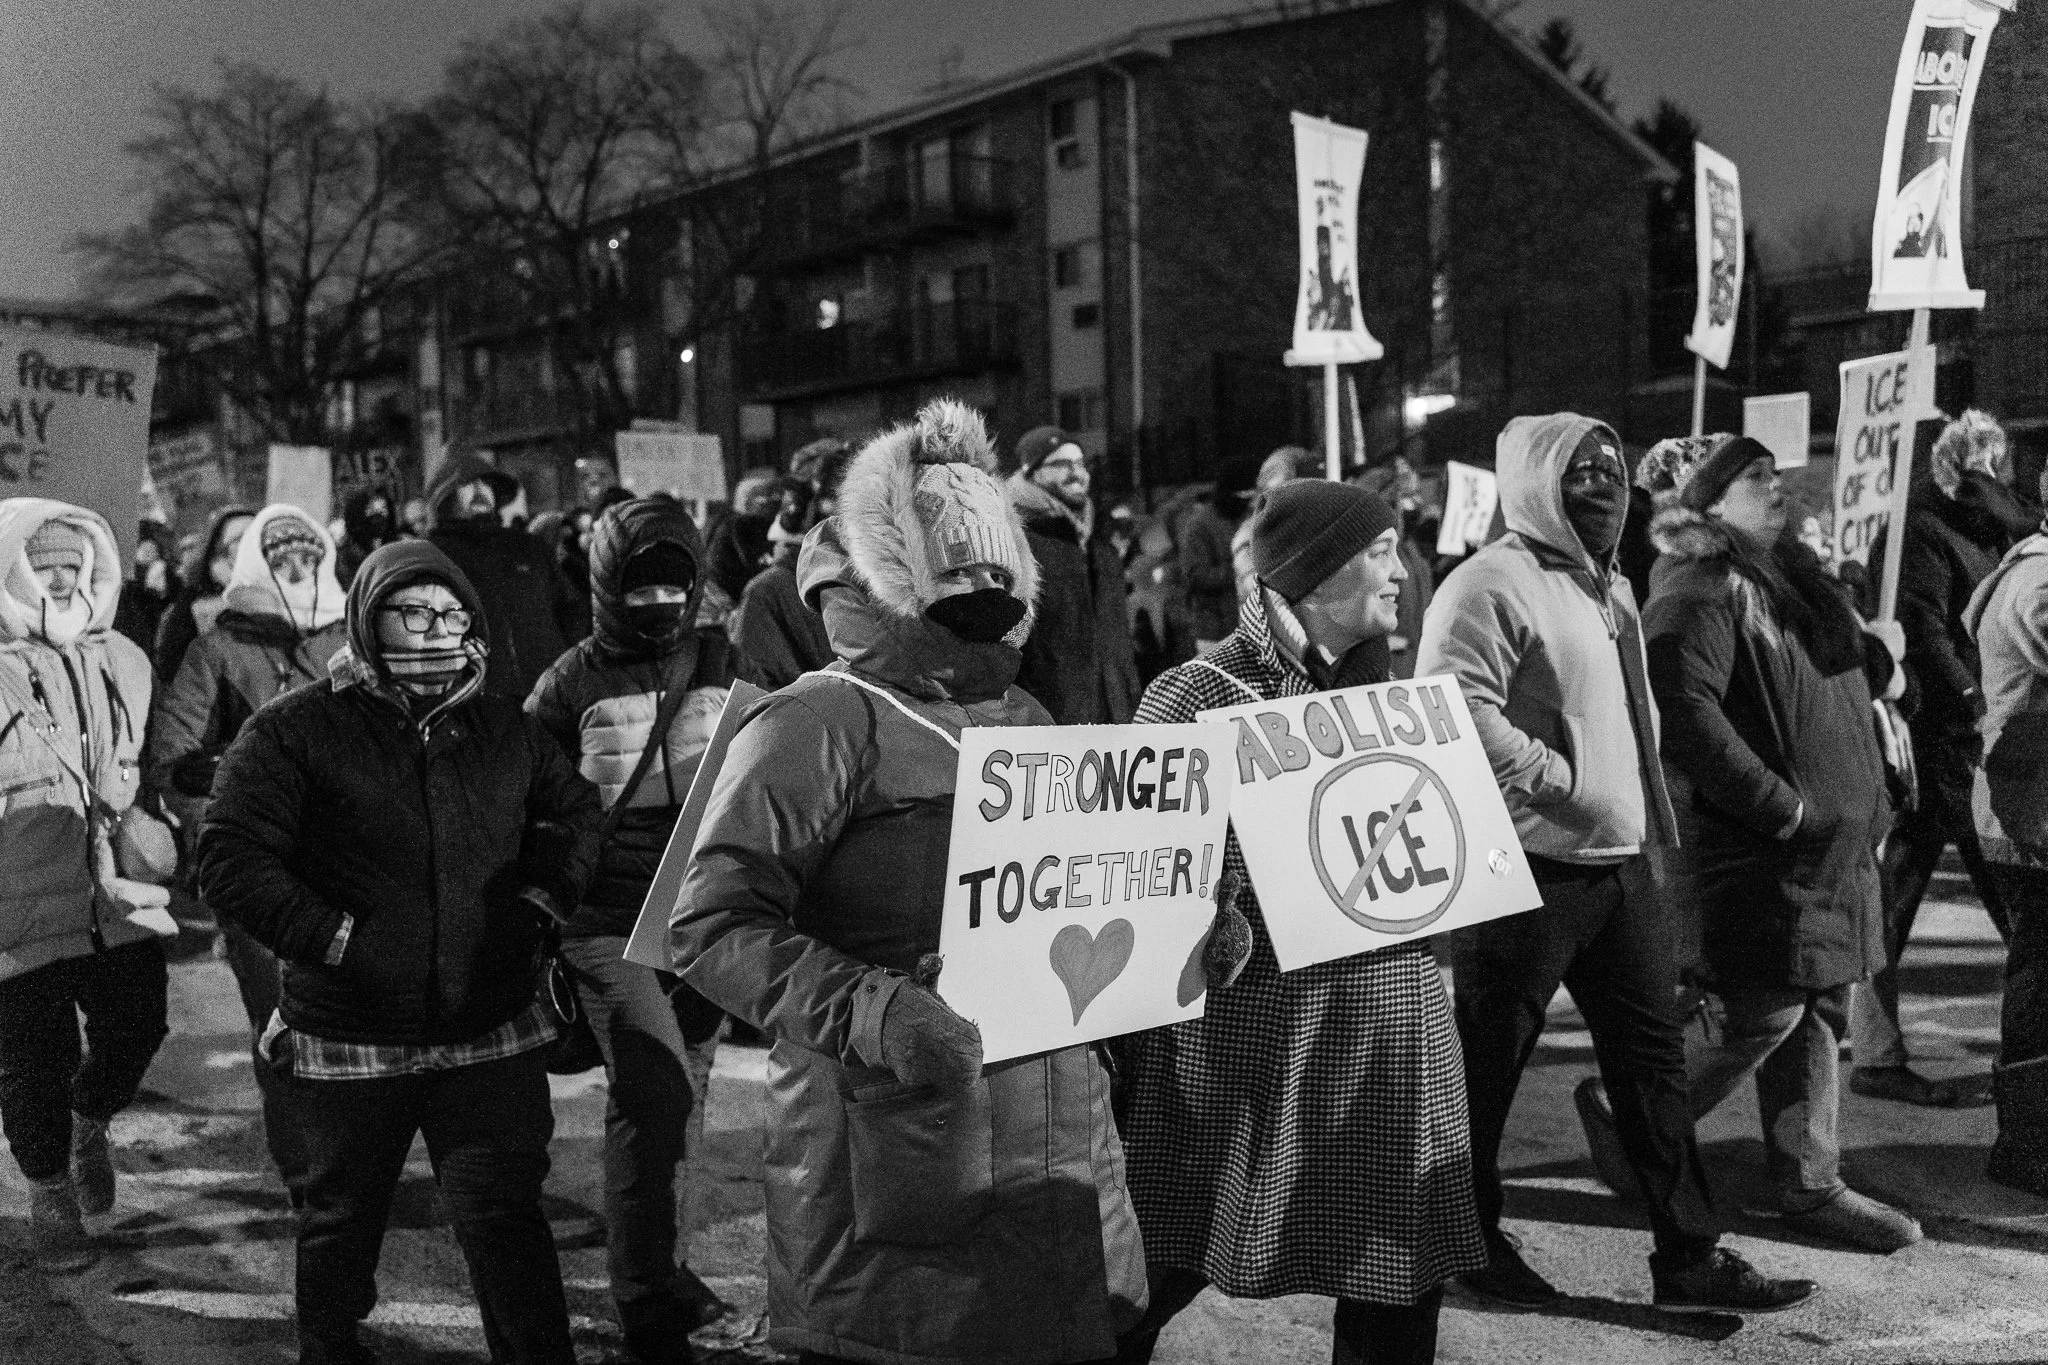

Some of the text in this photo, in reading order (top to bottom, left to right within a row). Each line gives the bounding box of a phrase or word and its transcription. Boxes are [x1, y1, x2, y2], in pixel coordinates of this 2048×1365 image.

[18, 349, 136, 403] PREFER
[1842, 472, 1867, 508] OF
[1229, 684, 1460, 785] ABOLISH
[978, 746, 1210, 822] STRONGER
[959, 844, 1214, 928] TOGETHER!
[1341, 800, 1449, 901] ICE
